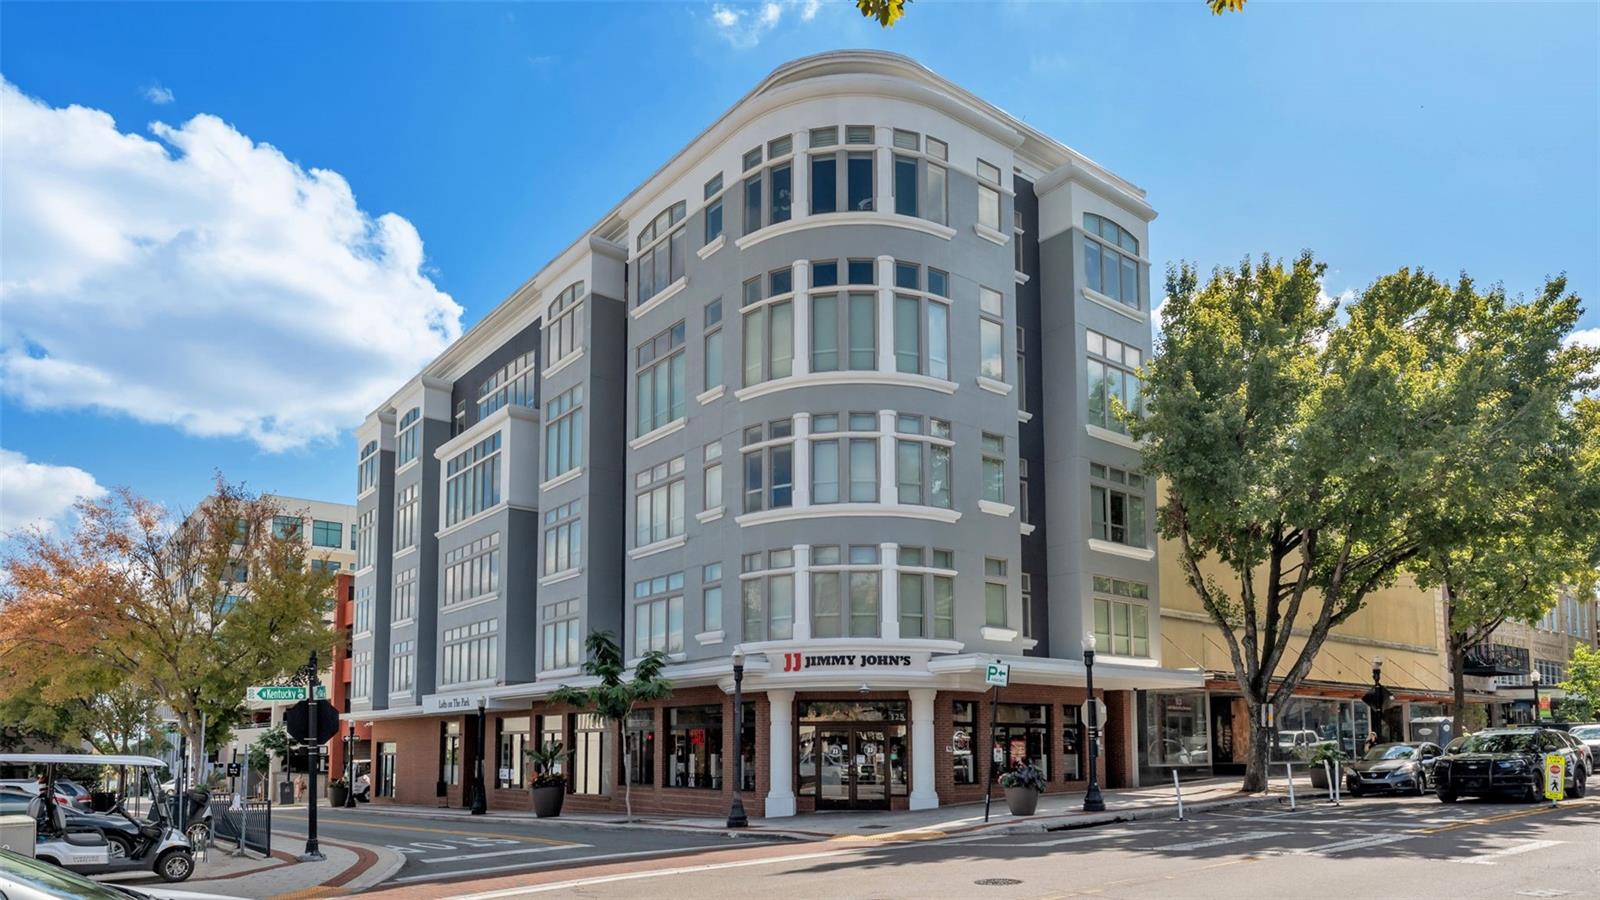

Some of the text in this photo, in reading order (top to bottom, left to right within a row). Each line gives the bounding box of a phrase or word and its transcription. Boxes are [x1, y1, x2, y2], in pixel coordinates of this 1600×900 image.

[784, 653, 801, 672] JJ
[804, 655, 911, 668] JIMMY JOHN'S
[267, 688, 297, 700] Kentucky
